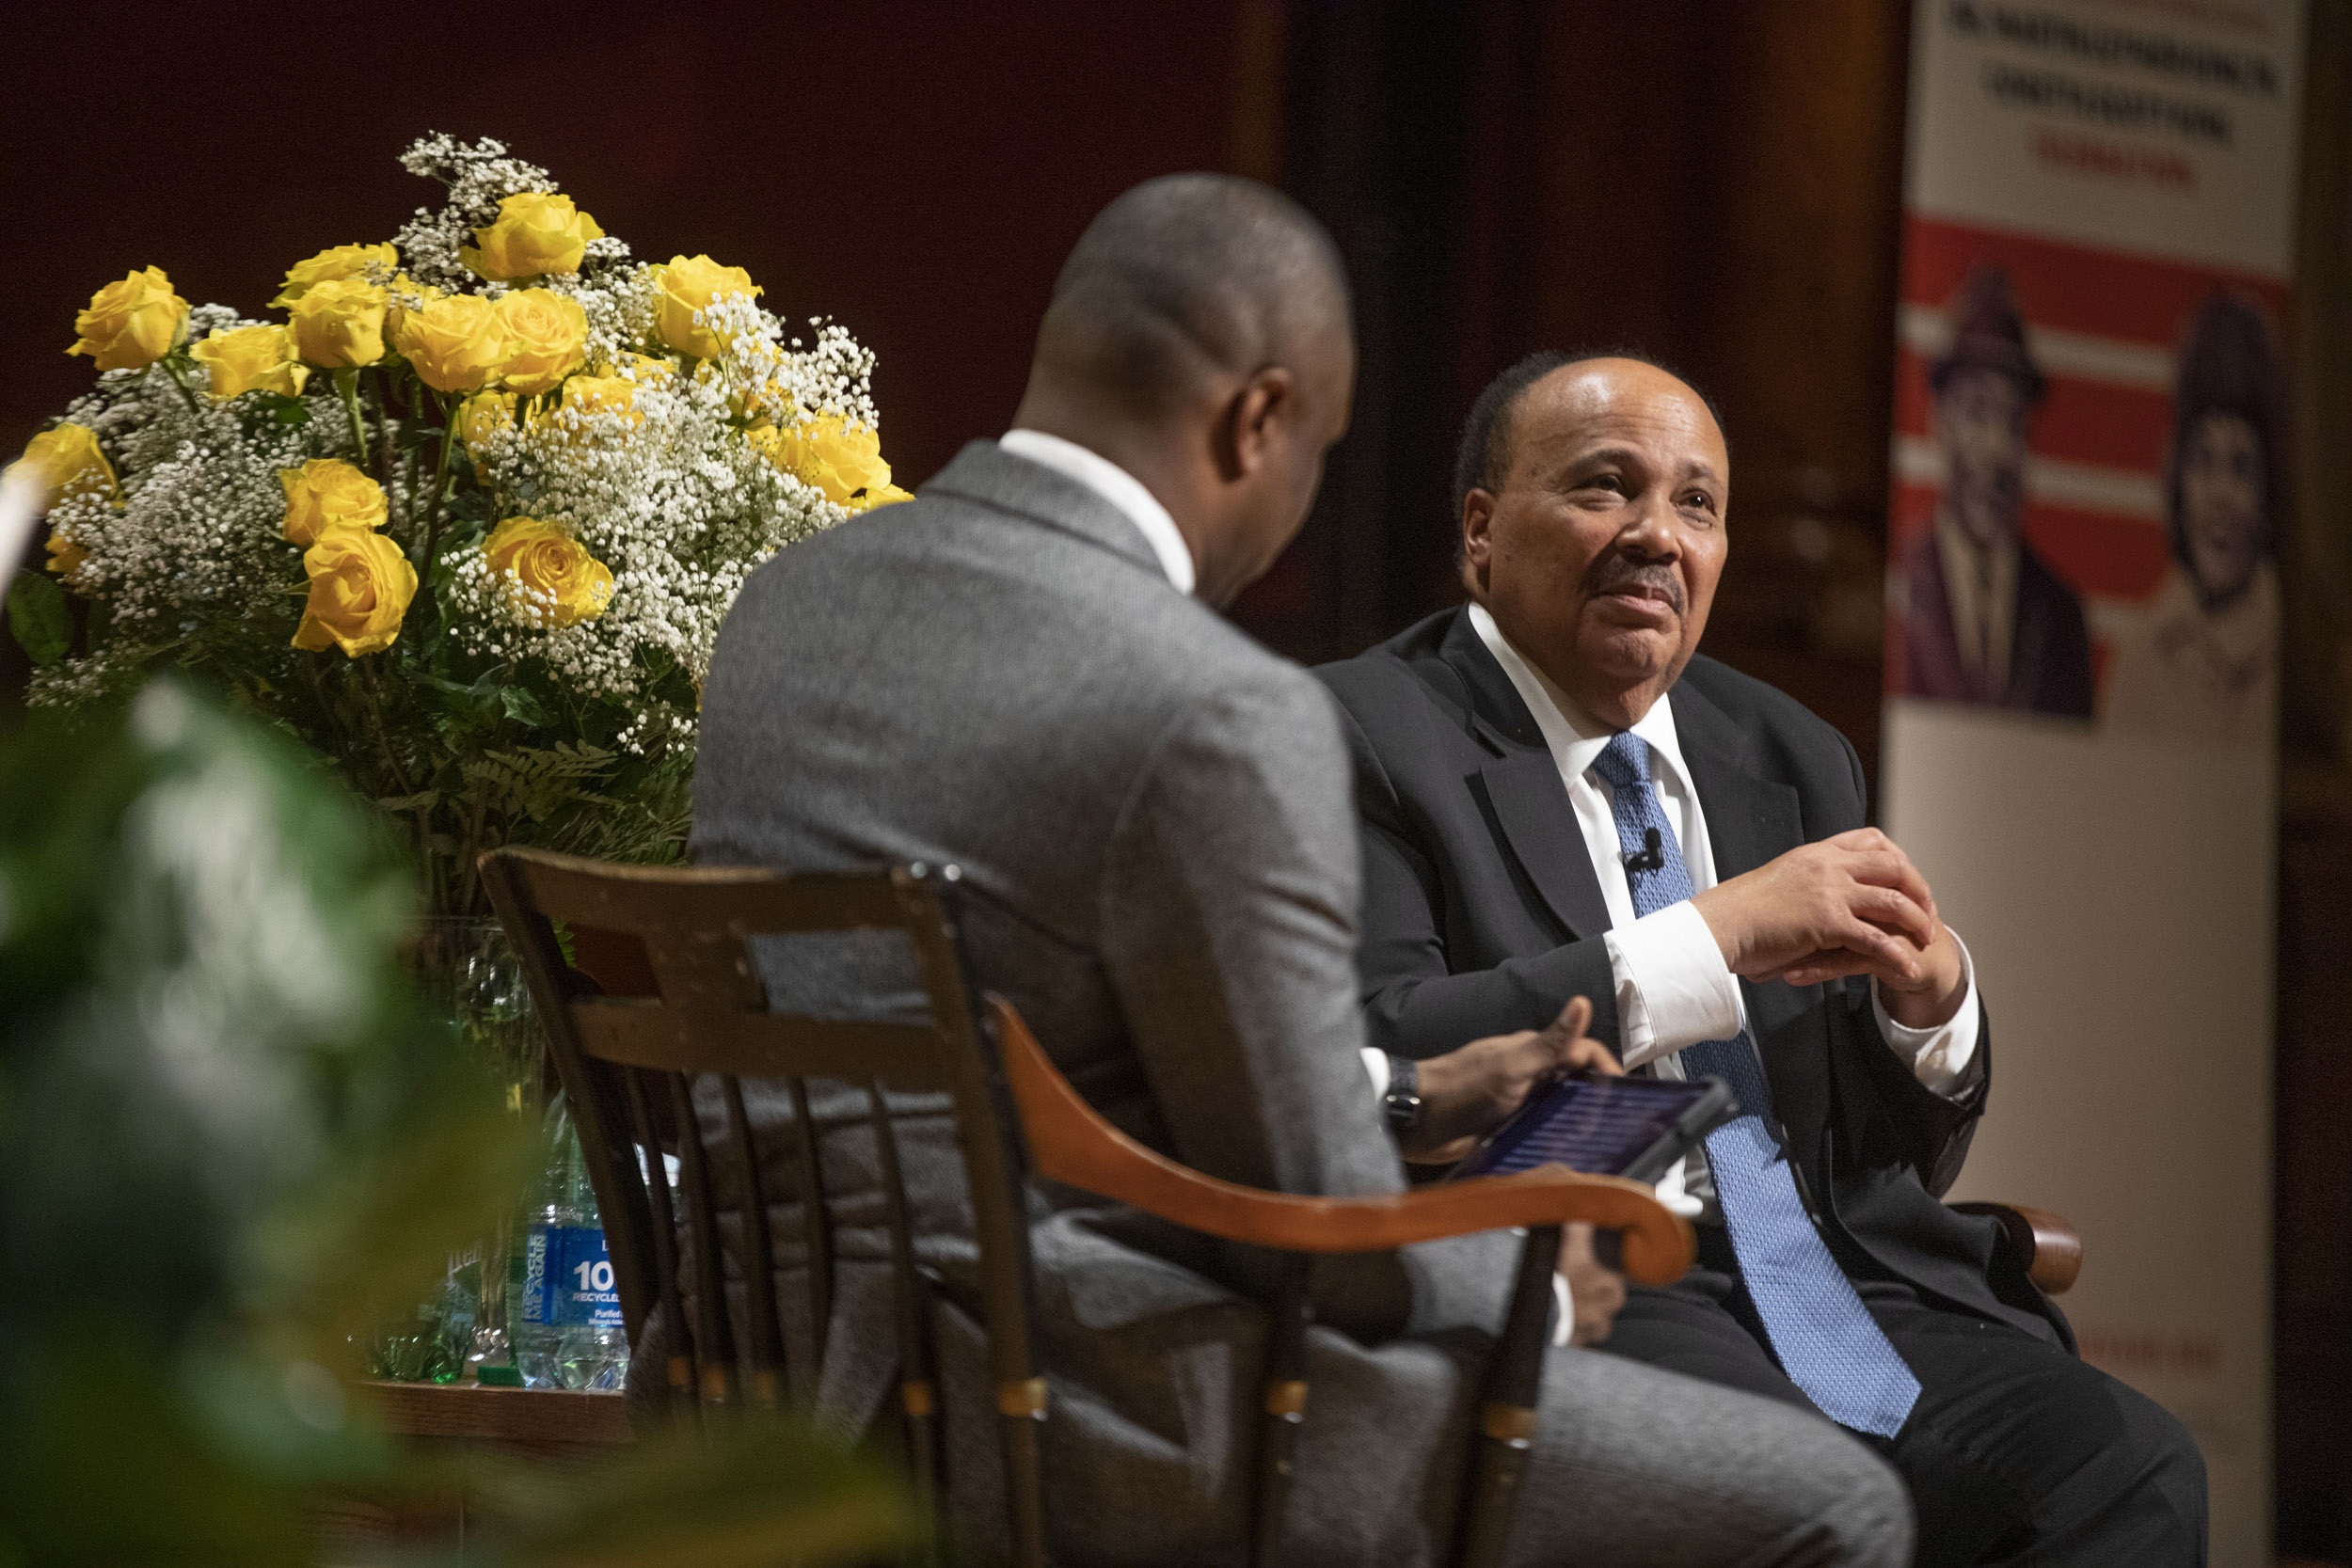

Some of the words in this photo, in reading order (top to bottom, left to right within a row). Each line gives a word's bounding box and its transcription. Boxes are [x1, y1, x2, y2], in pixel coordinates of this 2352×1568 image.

[524, 1234, 537, 1319] RECYCLE
[534, 1234, 546, 1288] AGAIN
[533, 1293, 543, 1320] ME
